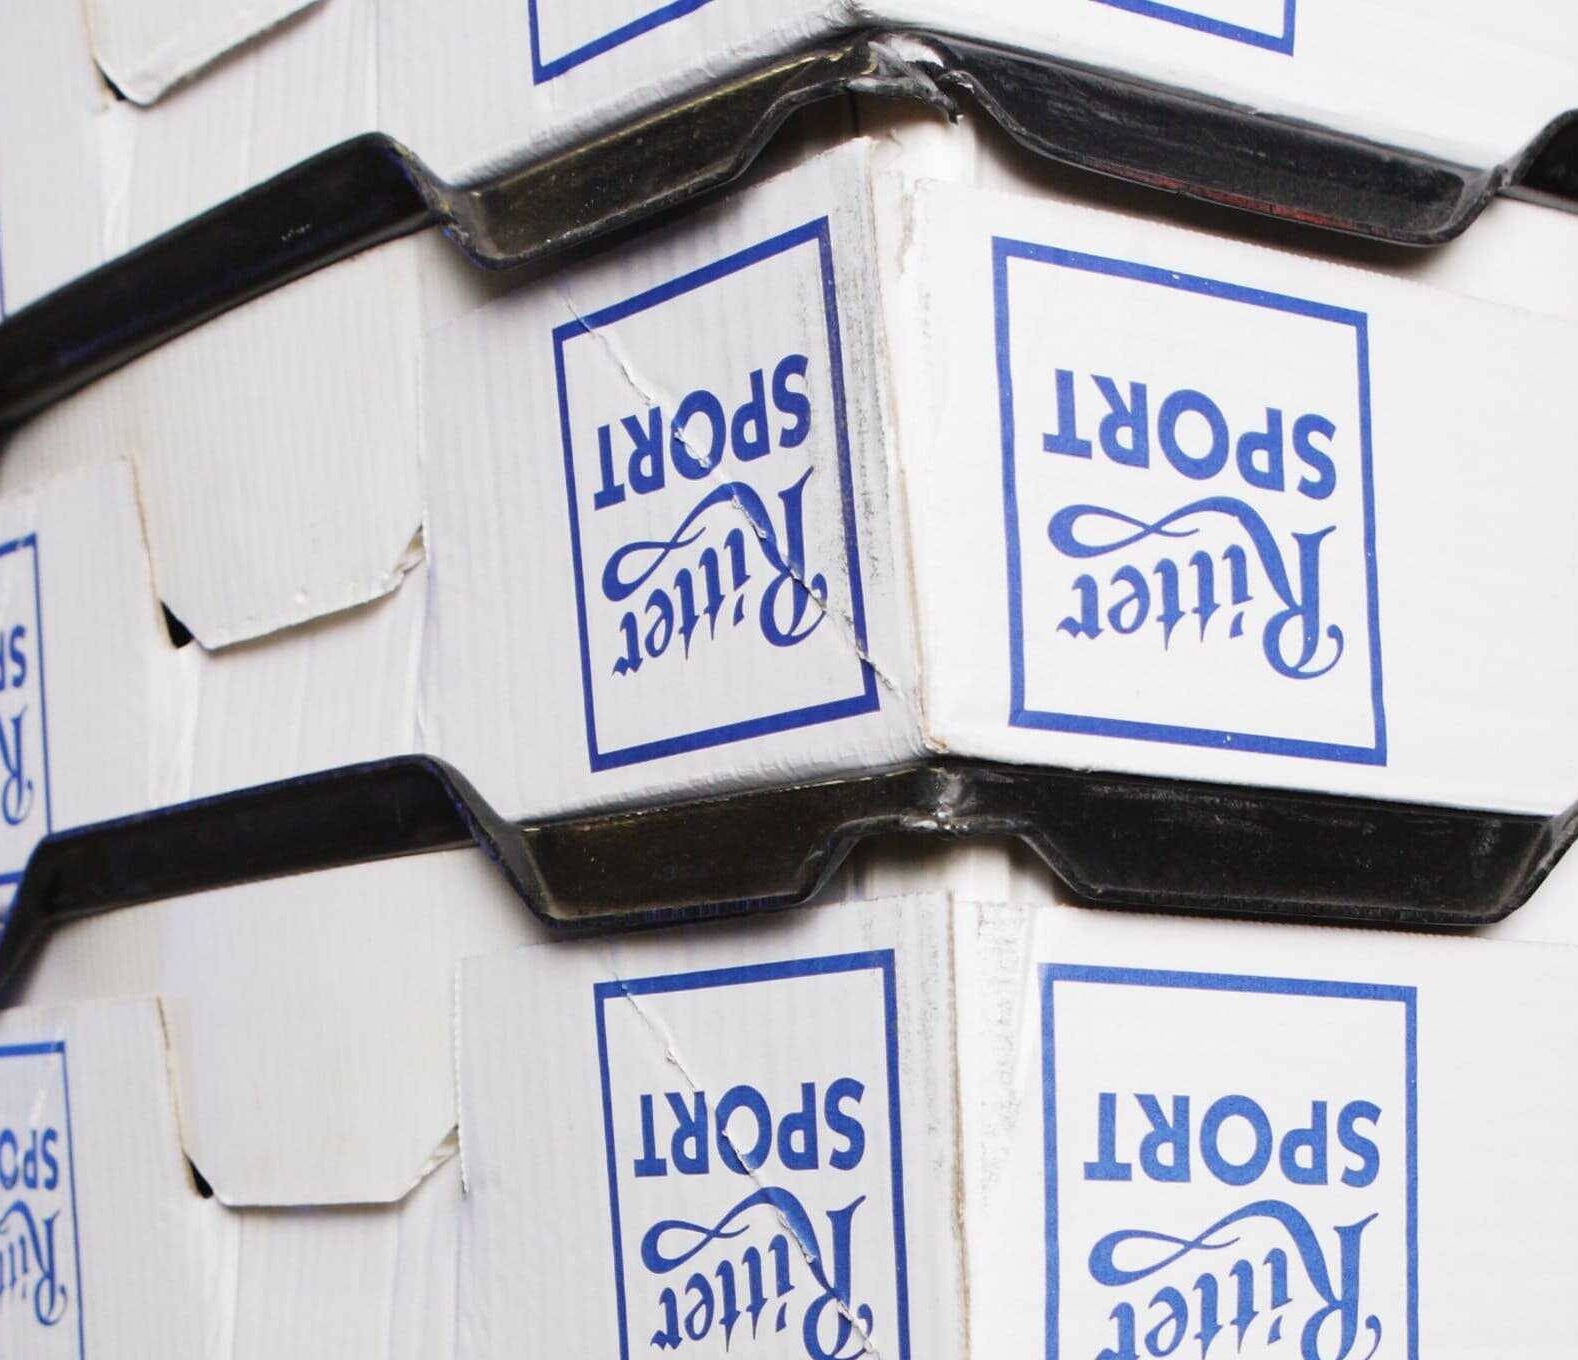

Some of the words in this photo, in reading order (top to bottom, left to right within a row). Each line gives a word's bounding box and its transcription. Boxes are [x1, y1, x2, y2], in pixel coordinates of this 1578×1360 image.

[593, 353, 810, 509] SPORT
[1042, 368, 1337, 501] SPORT
[602, 466, 827, 675] Ritter
[1046, 494, 1345, 681] Ritter
[633, 1076, 866, 1178] SPORT
[1083, 1091, 1382, 1188] SPORT
